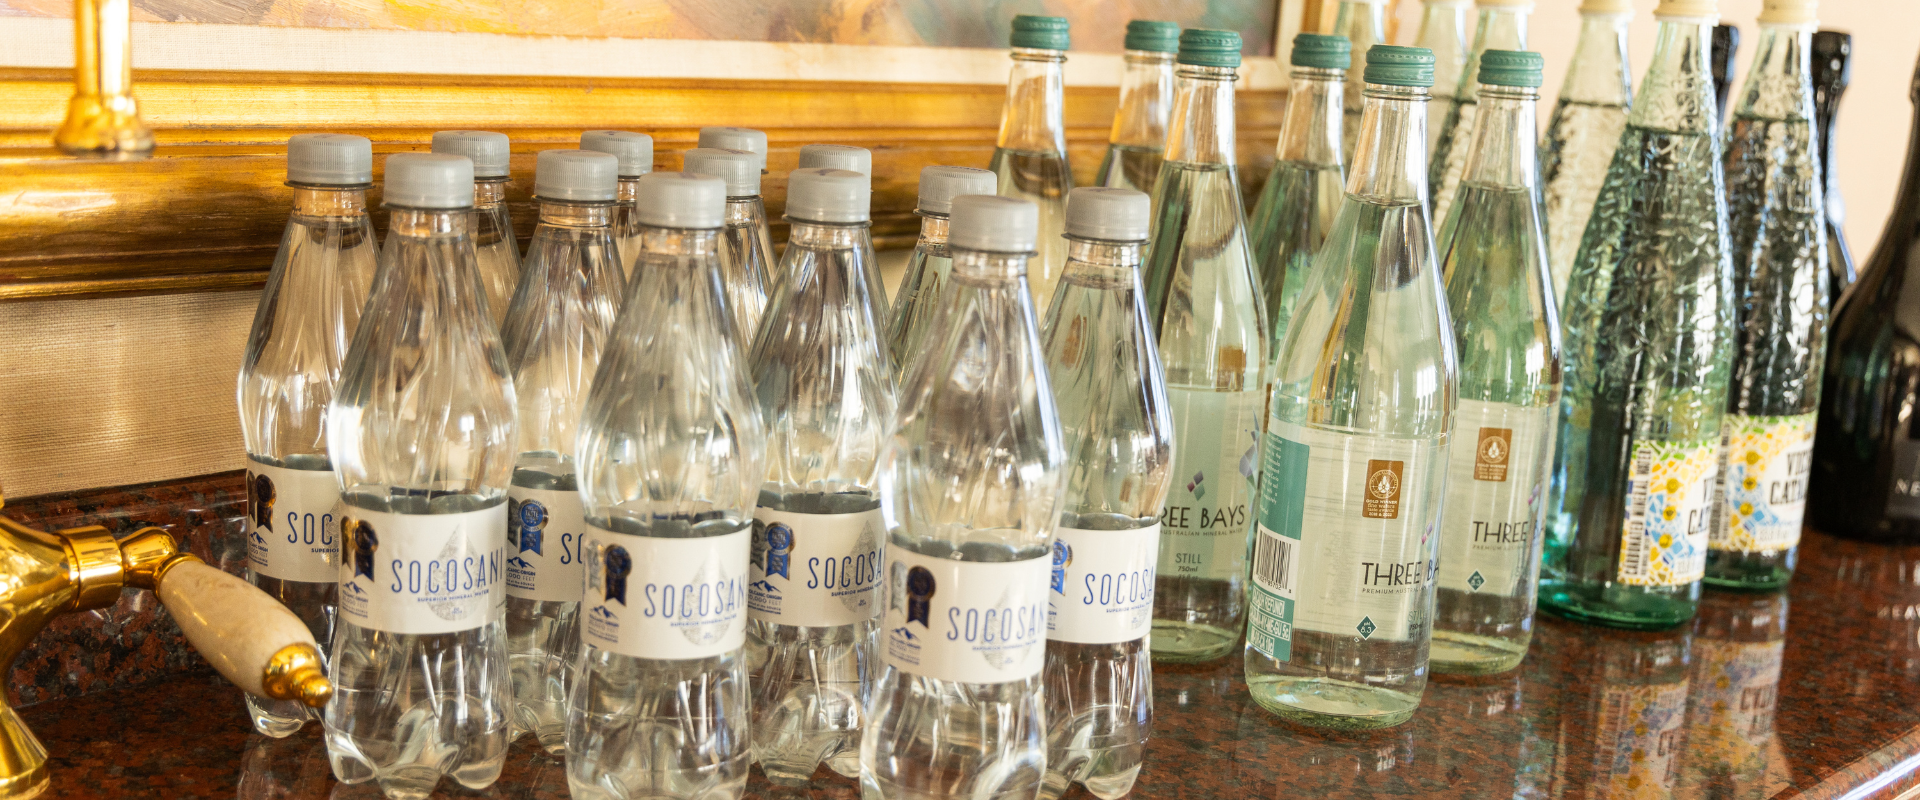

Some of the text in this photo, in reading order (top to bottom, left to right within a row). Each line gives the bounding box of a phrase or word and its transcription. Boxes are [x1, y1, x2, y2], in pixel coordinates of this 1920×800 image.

[1200, 504, 1245, 529] BAYS
[1473, 521, 1528, 543] THREE
[1175, 552, 1202, 564] STILL
[1362, 561, 1422, 586] THREE
[1360, 626, 1372, 634] 6.3
